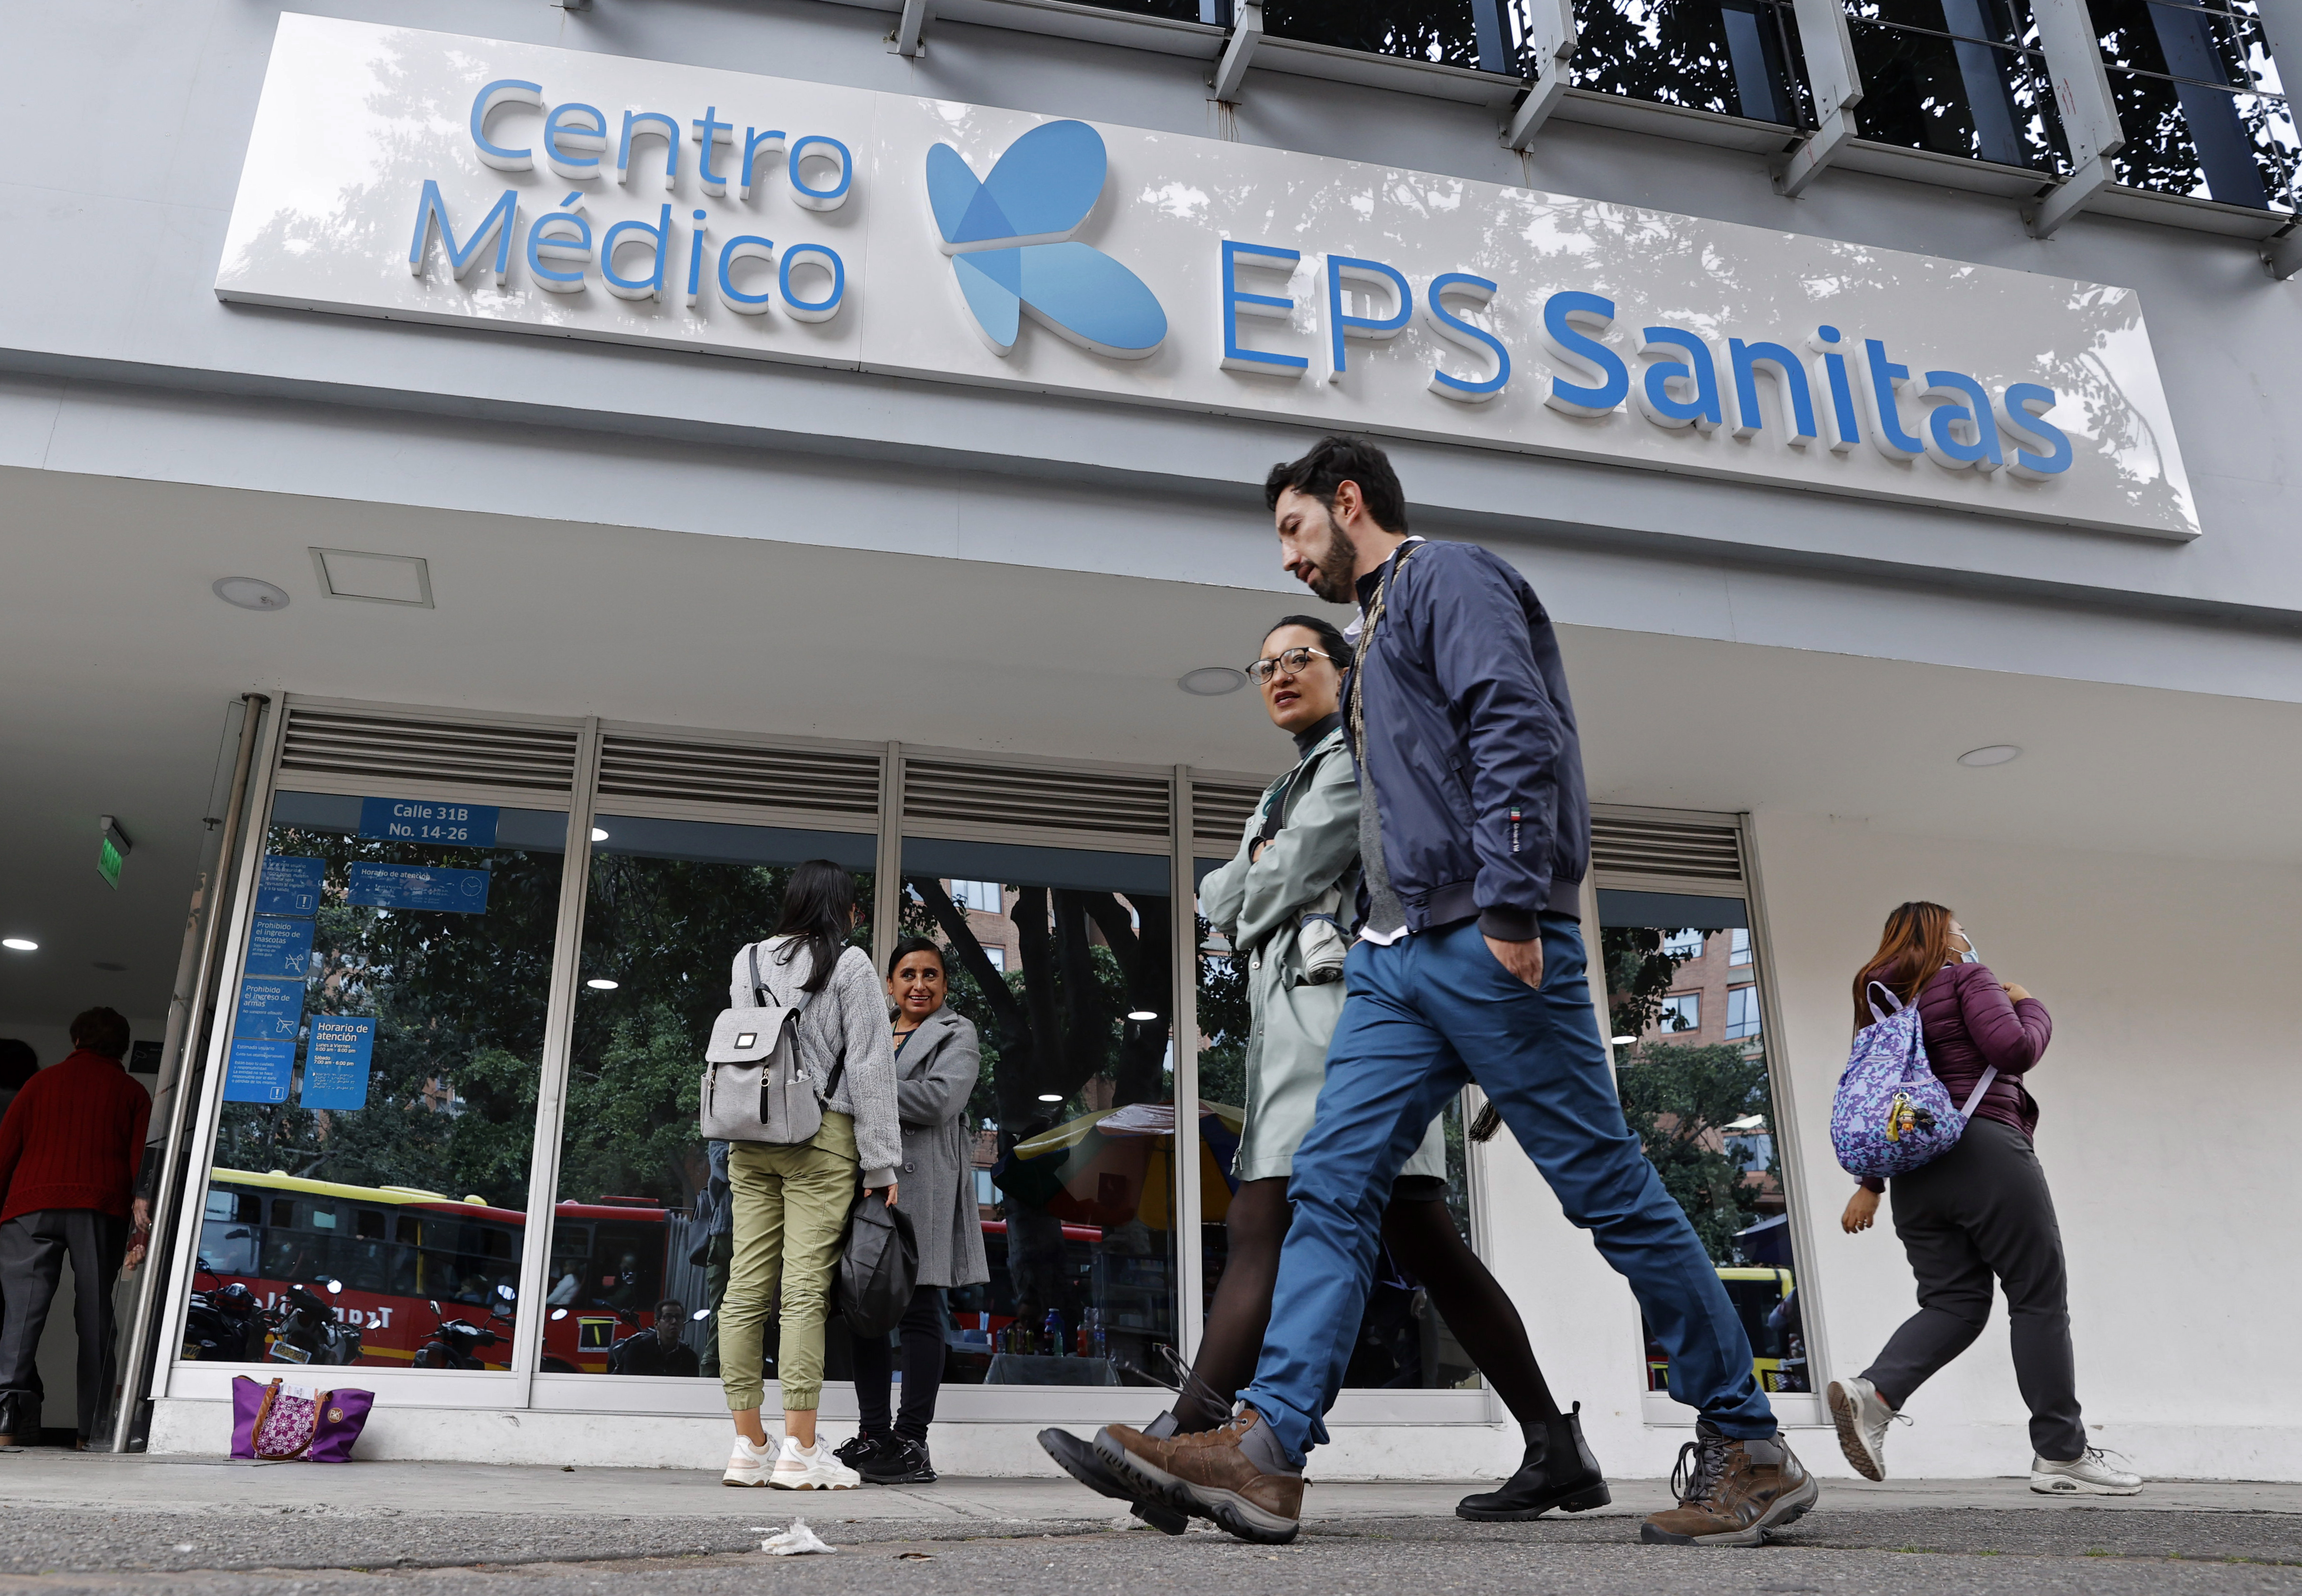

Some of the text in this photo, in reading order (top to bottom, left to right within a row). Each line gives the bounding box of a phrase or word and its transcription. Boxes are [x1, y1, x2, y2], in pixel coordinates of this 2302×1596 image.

[471, 79, 853, 211] Centro
[409, 179, 846, 322] Médico
[1219, 239, 2073, 479] EPS Sanitas
[394, 804, 468, 821] Calle 31B
[389, 823, 468, 840] No. 14-26
[361, 869, 388, 877] Horario
[400, 872, 431, 881] atención
[257, 921, 291, 930] Prohibido
[246, 985, 281, 994] Prohibido
[318, 1022, 368, 1033] Horario de
[317, 1032, 357, 1042] atención
